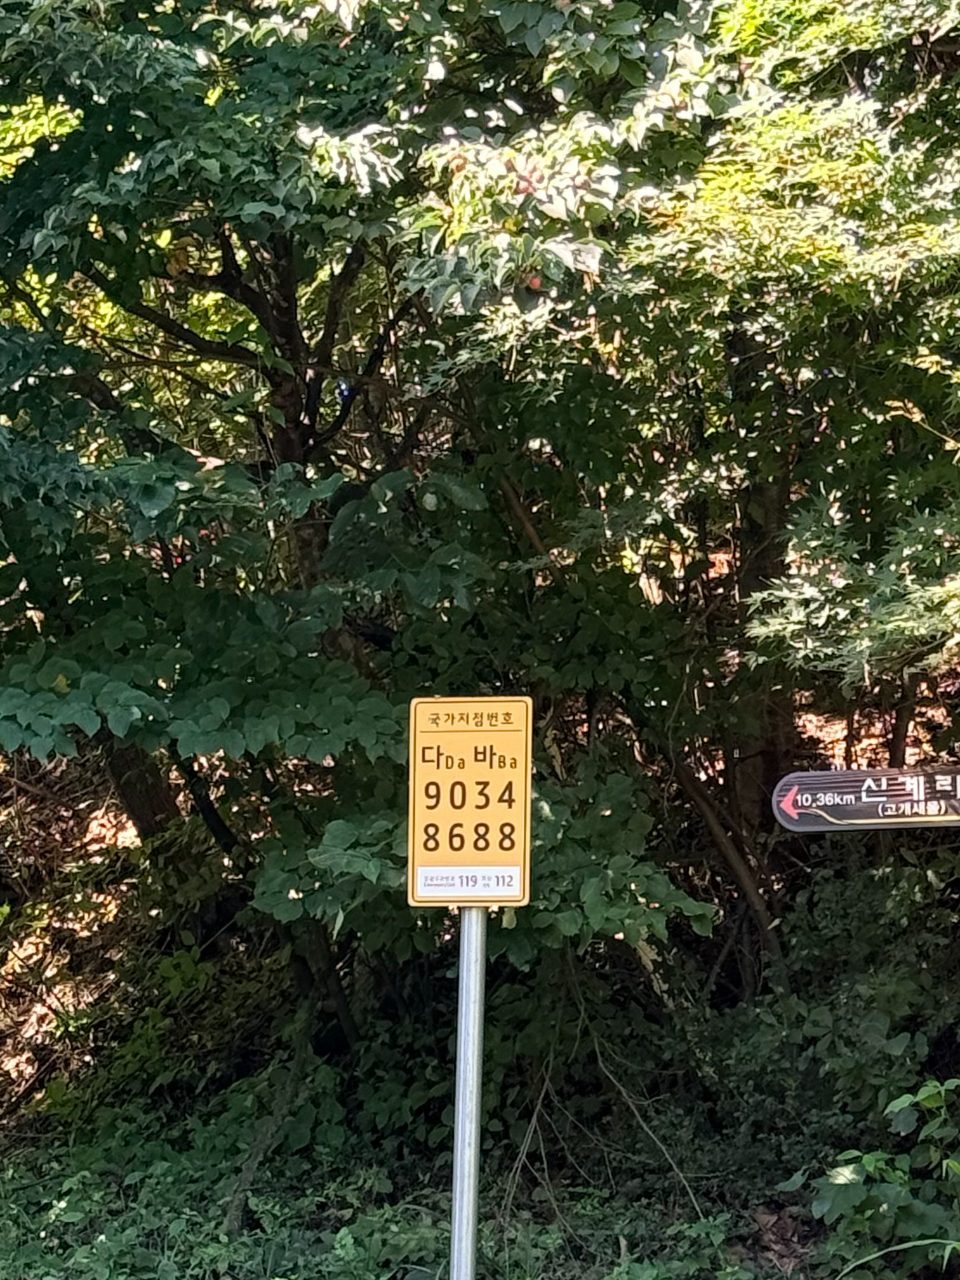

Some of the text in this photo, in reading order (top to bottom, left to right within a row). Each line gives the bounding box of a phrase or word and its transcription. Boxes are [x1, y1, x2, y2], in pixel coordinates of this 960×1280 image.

[428, 712, 514, 727] 국가지정번호
[424, 780, 516, 810] 9034
[423, 822, 516, 852] 8688
[458, 875, 478, 888] 119
[495, 874, 514, 888] 112
